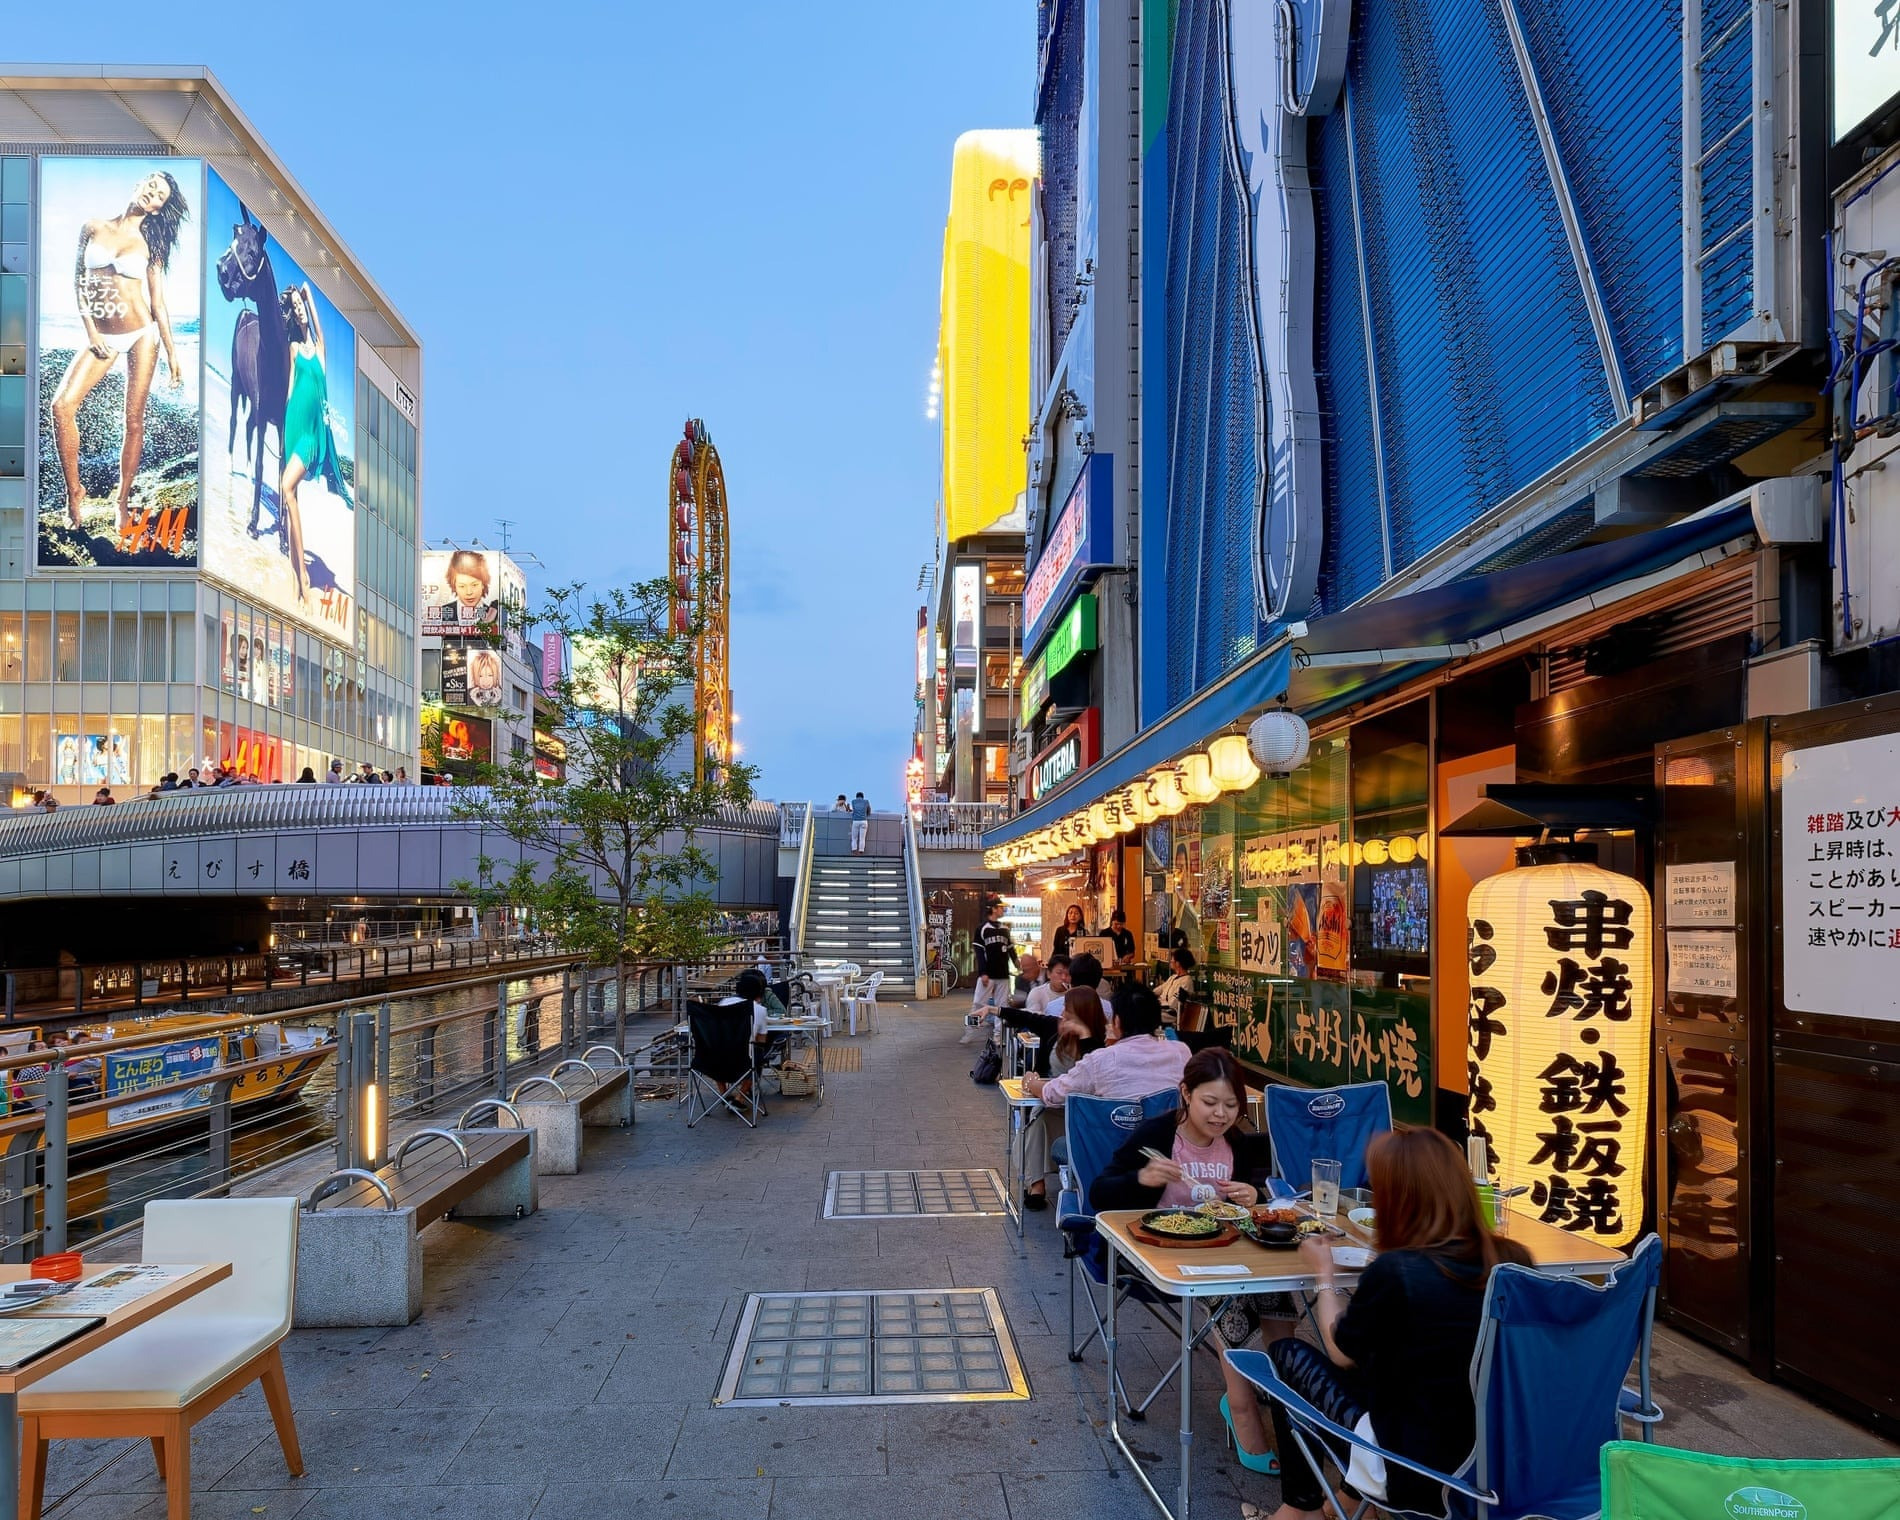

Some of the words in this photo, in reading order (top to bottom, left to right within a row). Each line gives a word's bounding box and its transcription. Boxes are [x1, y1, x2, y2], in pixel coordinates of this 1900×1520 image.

[114, 506, 189, 554] H&M
[1039, 738, 1077, 792] LOTTERIA
[1807, 806, 1900, 834] 雑踏及び大
[1807, 838, 1894, 862] 上昇時は、
[168, 859, 311, 881] えびす橋
[1808, 897, 1900, 917] スピーカー
[1241, 928, 1279, 966] 串カツ
[1808, 927, 1900, 949] 速やかに退
[1293, 1000, 1423, 1098] お好み焼
[1528, 890, 1635, 1235] 串焼・鉄板焼
[114, 1057, 164, 1079] とんぼり
